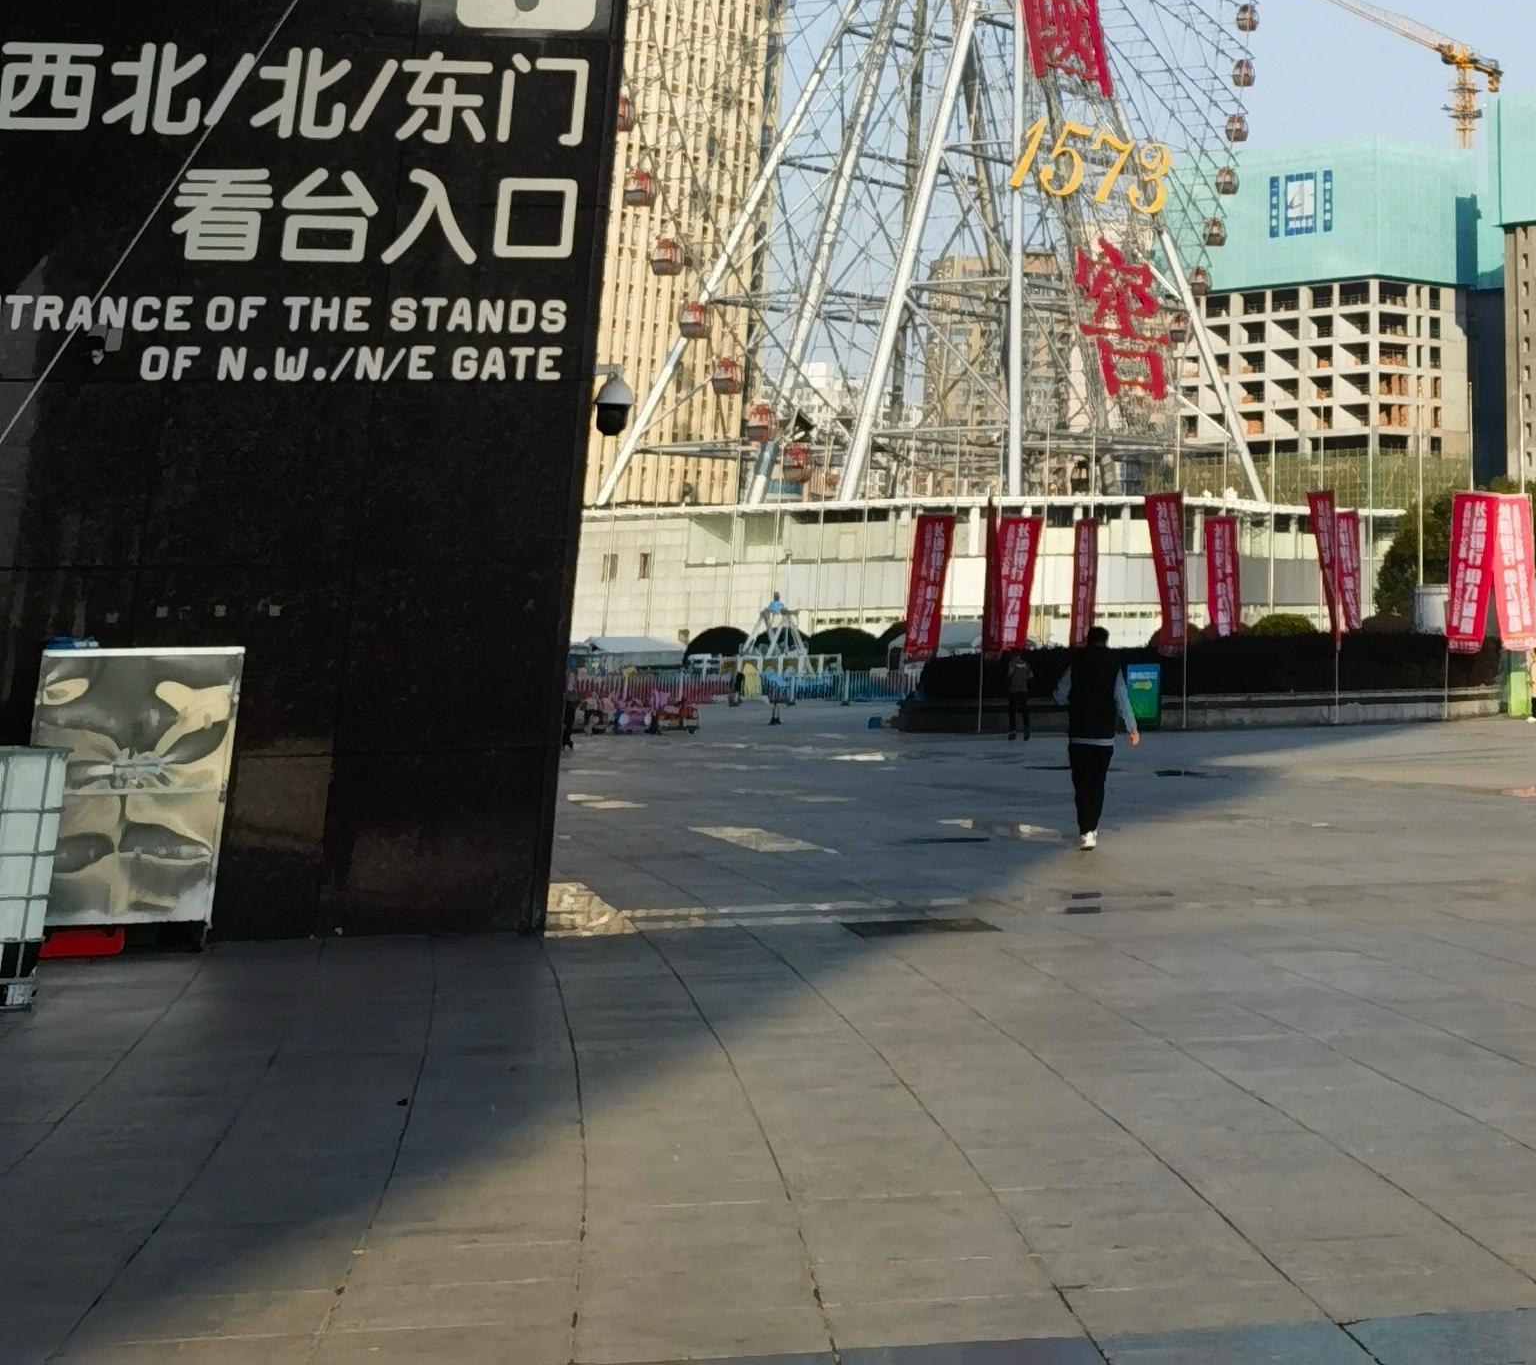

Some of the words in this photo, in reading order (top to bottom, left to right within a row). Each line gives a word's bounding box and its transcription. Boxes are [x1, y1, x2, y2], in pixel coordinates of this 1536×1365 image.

[0, 41, 591, 147] 西北/北/东门
[1009, 117, 1173, 214] 1573
[171, 168, 579, 266] 看台入口
[0, 294, 194, 332] TRANCE
[205, 295, 268, 332] OF
[284, 295, 371, 332] THE
[390, 297, 568, 334] STANDS
[139, 345, 199, 381] OF
[217, 346, 435, 381] N.W./N/E
[451, 346, 564, 381] GATE
